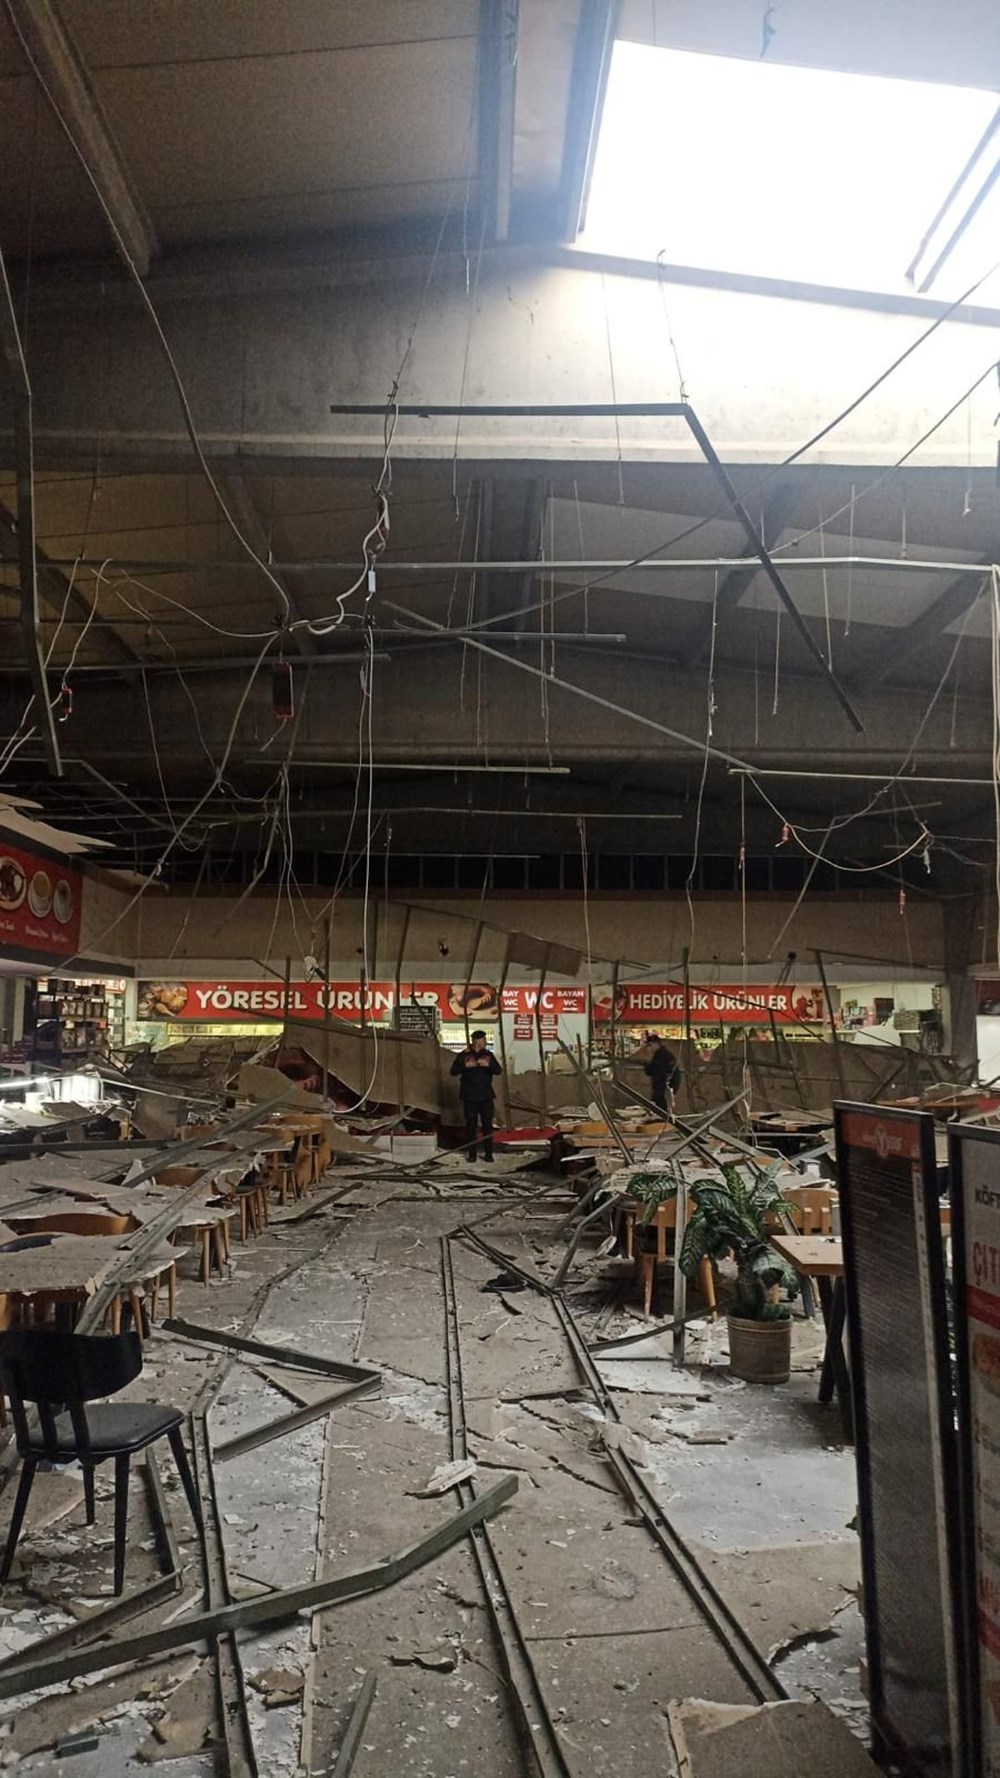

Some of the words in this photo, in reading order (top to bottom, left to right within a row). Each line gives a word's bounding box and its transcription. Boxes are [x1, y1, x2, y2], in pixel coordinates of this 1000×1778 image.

[195, 985, 308, 1010] YÖRESEL
[524, 991, 555, 1009] WC
[712, 990, 788, 1011] ÜRÜNLER
